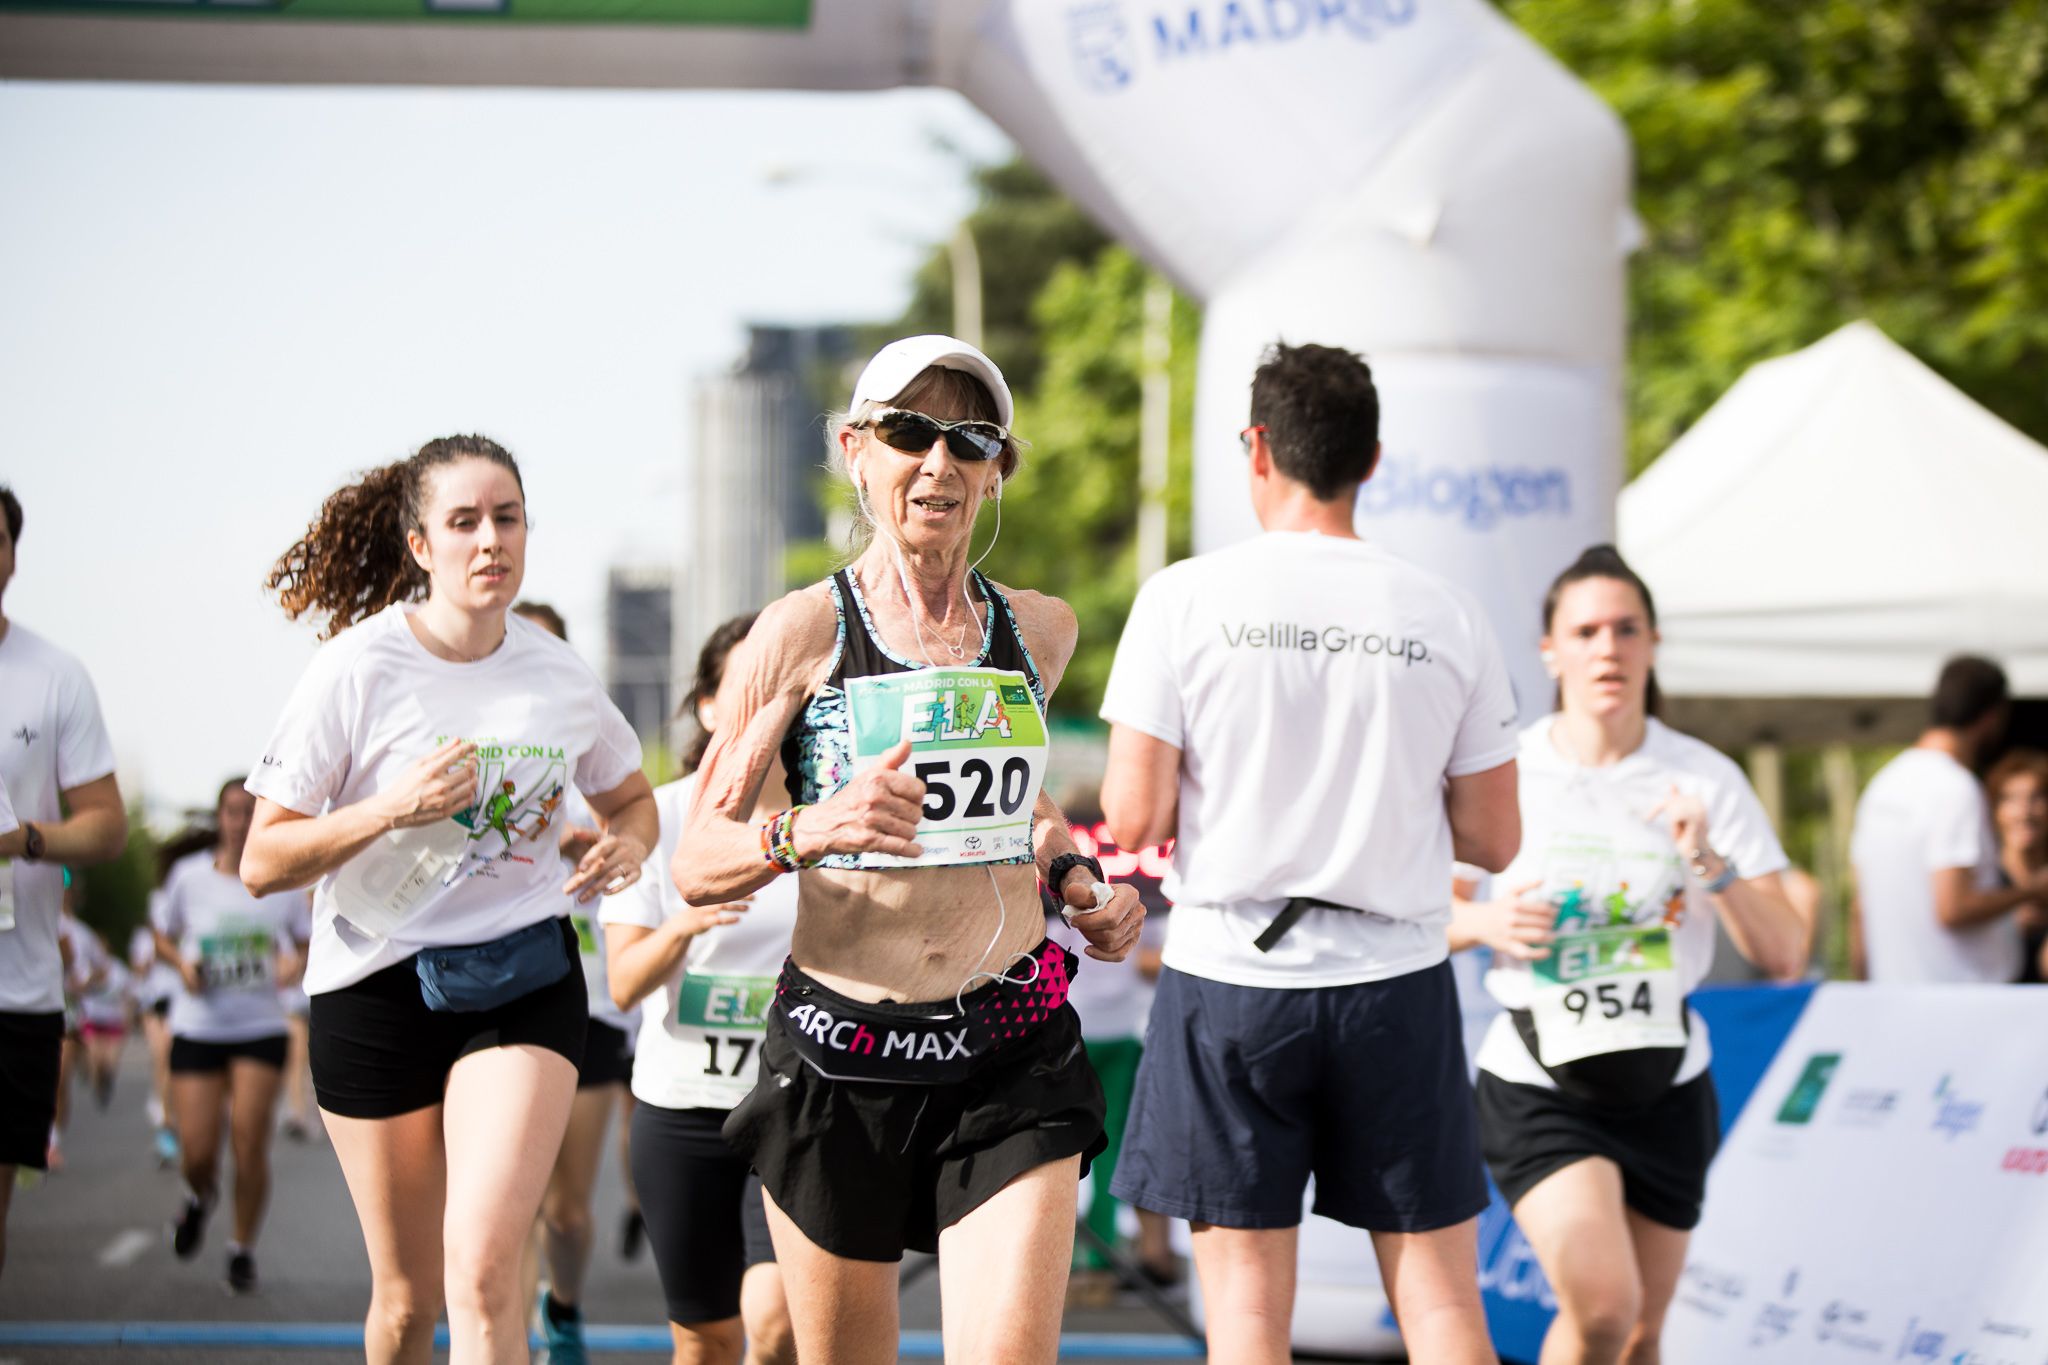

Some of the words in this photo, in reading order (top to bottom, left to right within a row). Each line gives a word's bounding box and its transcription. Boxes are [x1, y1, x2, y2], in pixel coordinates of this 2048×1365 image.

[903, 677, 955, 693] MADRID
[957, 677, 979, 688] CON
[981, 678, 994, 688] LA
[901, 690, 1012, 743] ELA
[508, 745, 543, 758] CON
[548, 746, 565, 759] LA
[914, 756, 1030, 822] 520
[703, 986, 773, 1024] EL
[1563, 980, 1652, 1024] 954
[882, 1028, 972, 1061] MAX
